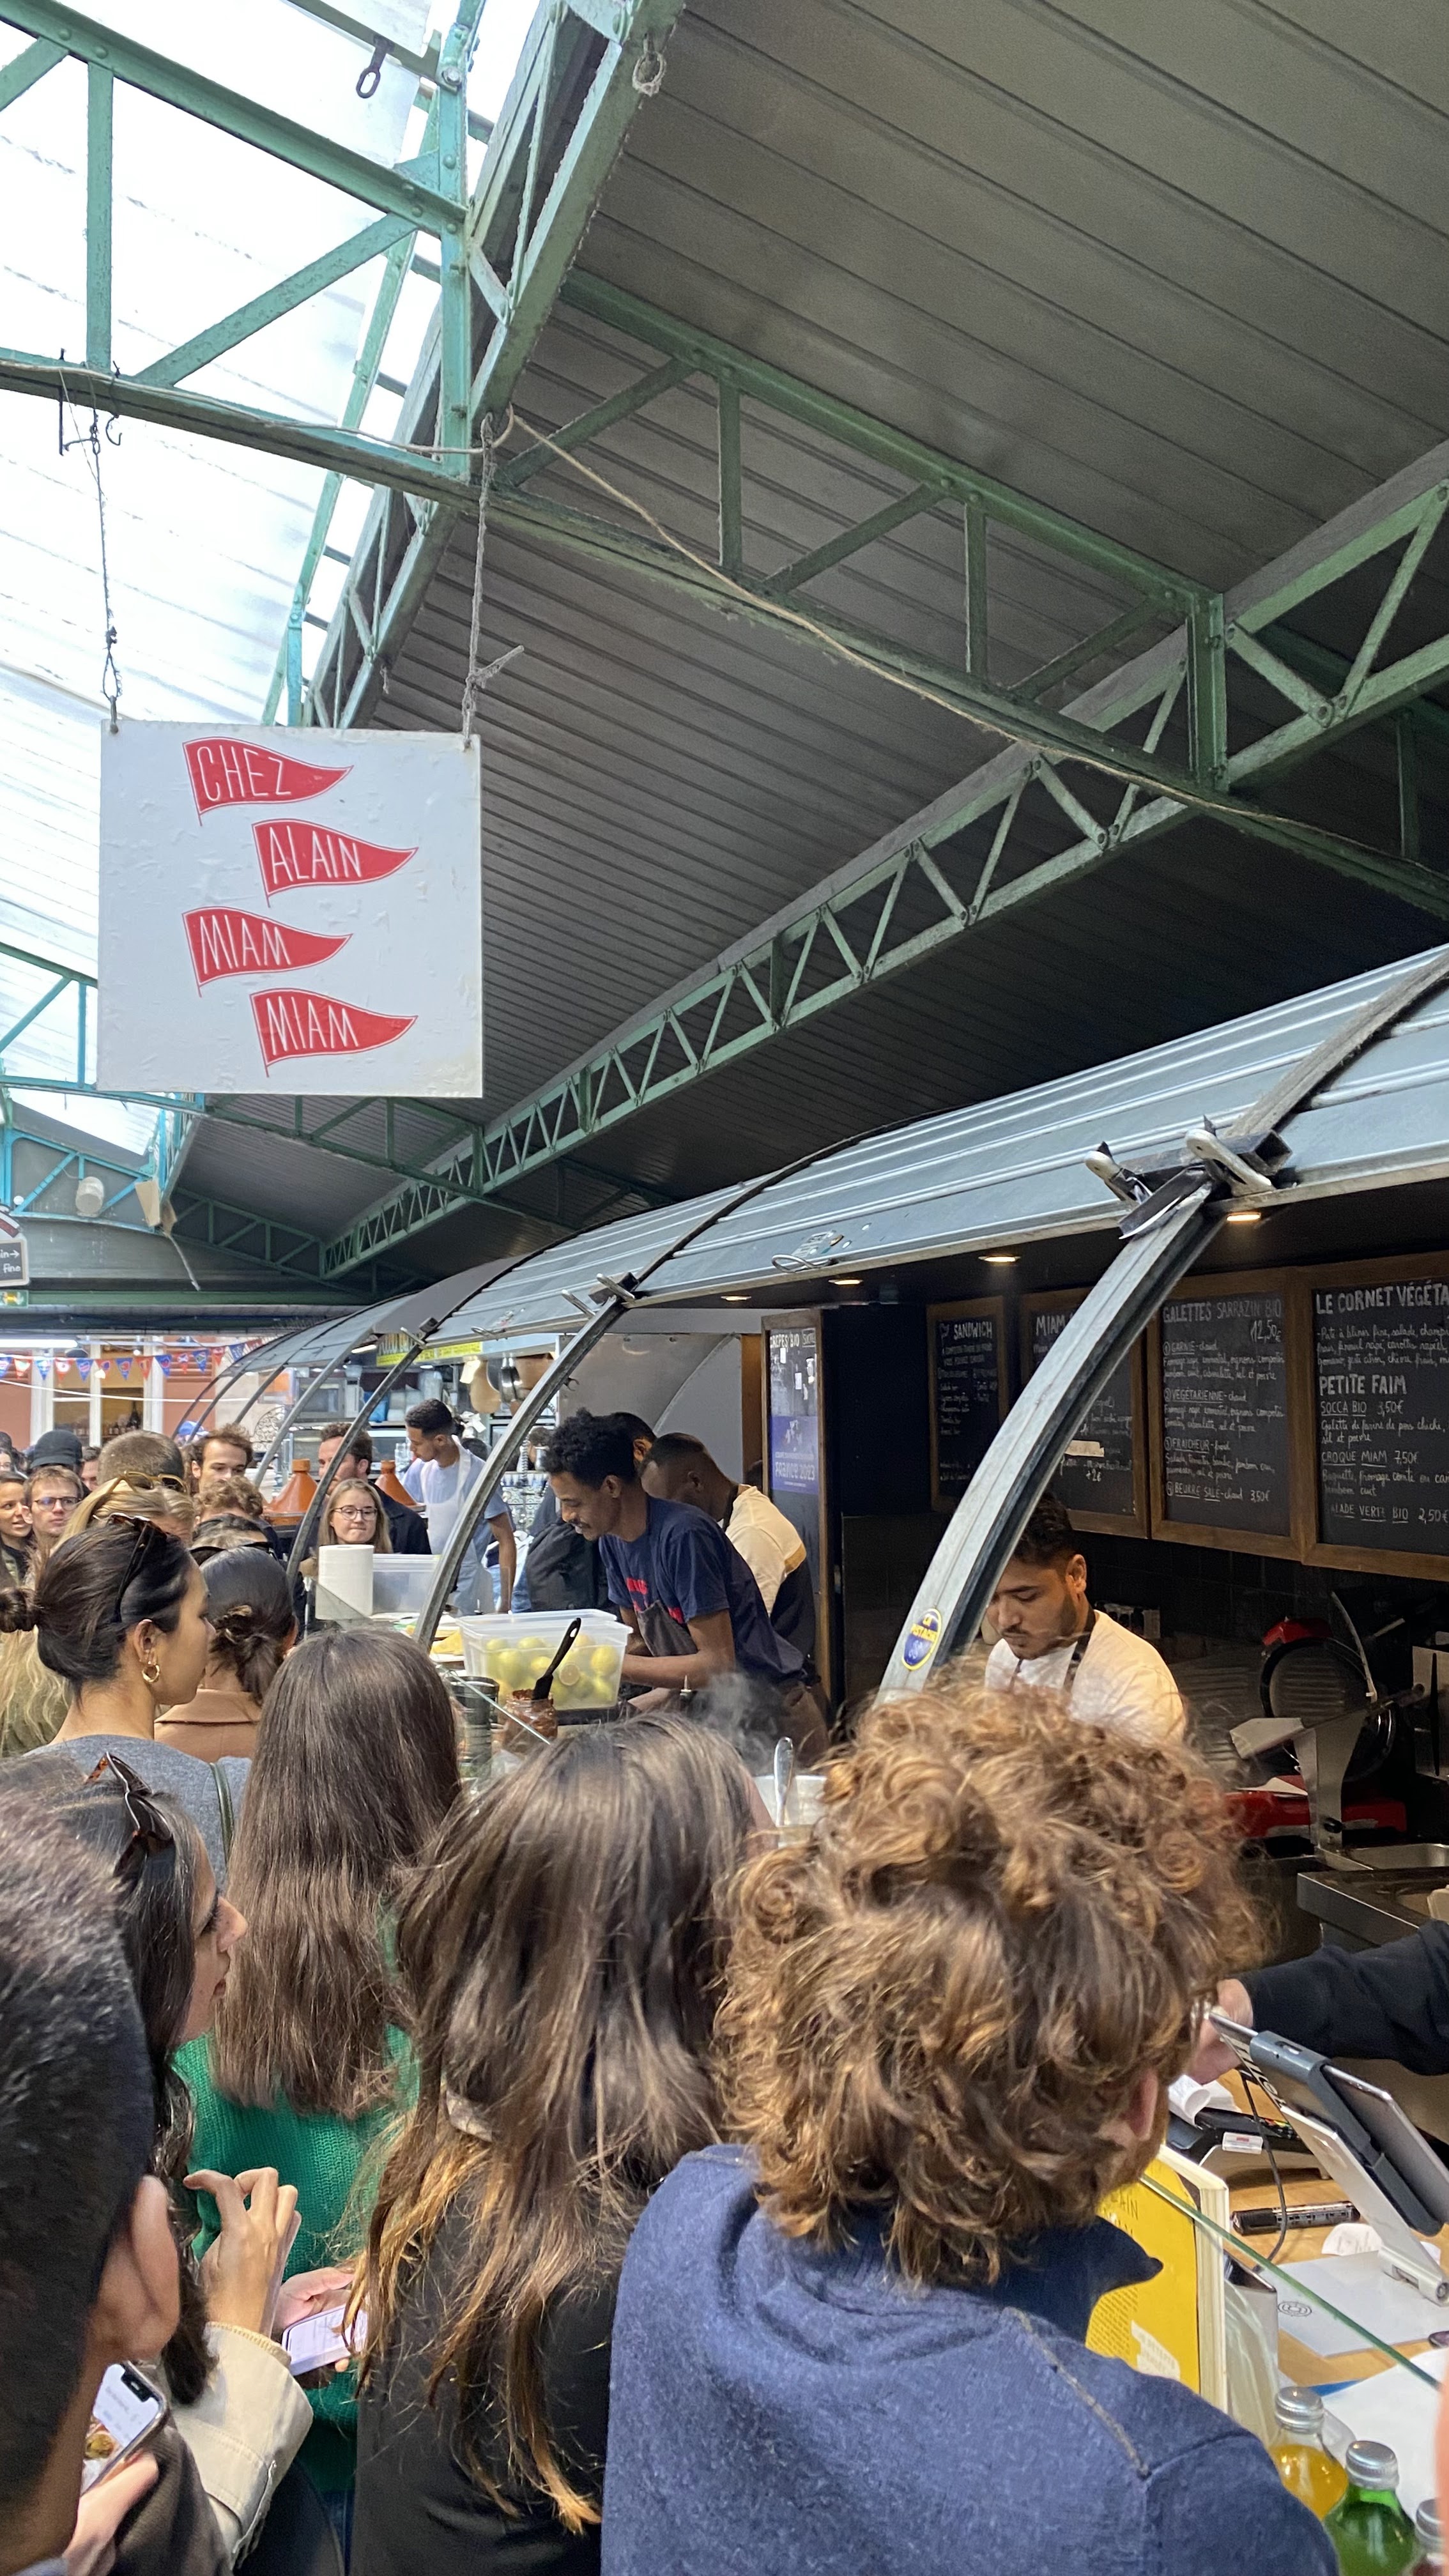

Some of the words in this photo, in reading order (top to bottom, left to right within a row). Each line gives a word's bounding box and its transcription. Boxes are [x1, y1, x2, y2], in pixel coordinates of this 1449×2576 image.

[197, 745, 293, 802] CHEZ
[270, 825, 362, 885] ALAIN
[199, 914, 292, 975] MIAM
[266, 996, 359, 1056] MIAM
[0, 1249, 9, 1259] in
[1163, 1302, 1211, 1322] GALETTES
[1217, 1300, 1260, 1319] SARRAZIN
[1266, 1299, 1282, 1317] BIO
[1316, 1294, 1333, 1314] LE
[1337, 1286, 1393, 1312] CORNET
[954, 1322, 992, 1340] SANDWICH
[1036, 1315, 1065, 1336] MIAM
[1319, 1374, 1365, 1396] PETITE
[1372, 1375, 1407, 1395] FAIM
[1321, 1401, 1348, 1413] SOCCA
[1353, 1401, 1367, 1413] BIO
[1322, 1451, 1356, 1463] CROQUE
[1361, 1450, 1387, 1462] MIAM
[1393, 1506, 1408, 1520] BIO
